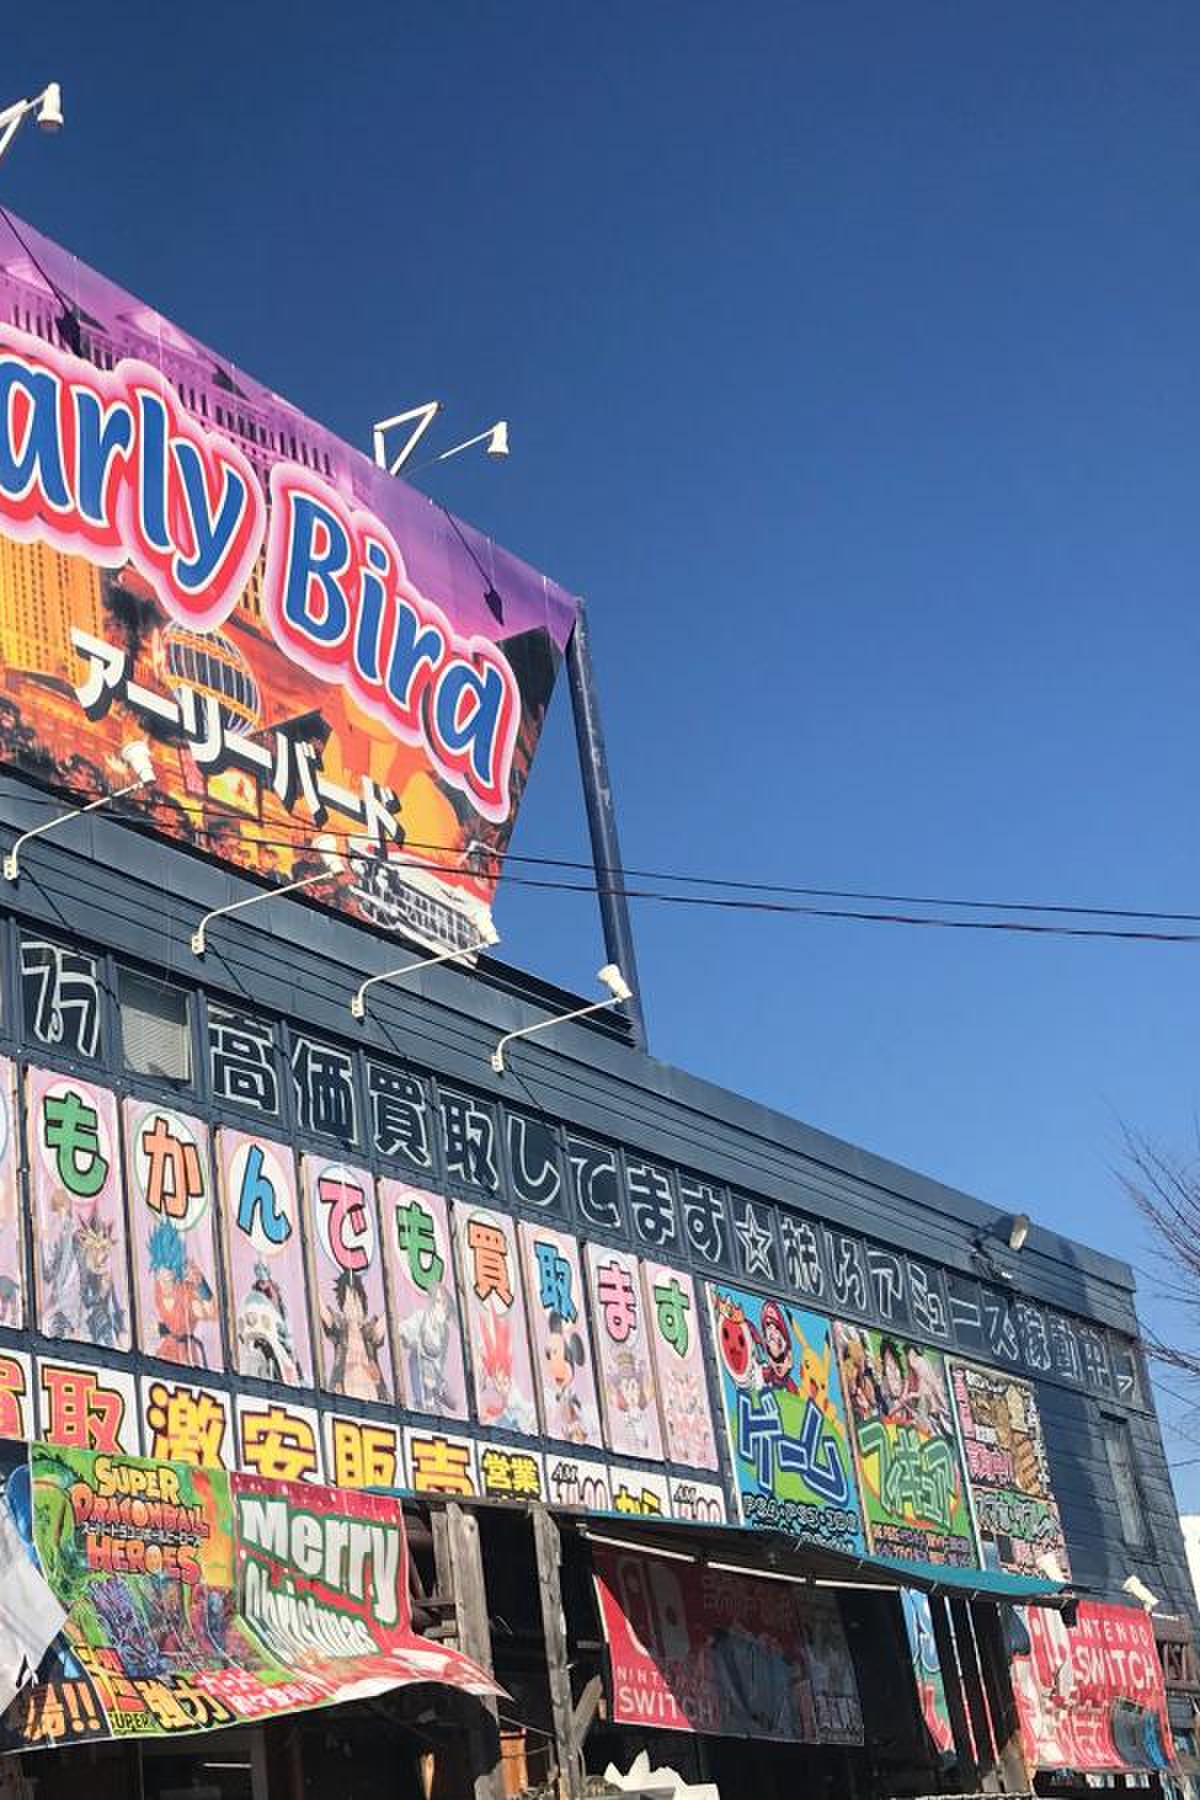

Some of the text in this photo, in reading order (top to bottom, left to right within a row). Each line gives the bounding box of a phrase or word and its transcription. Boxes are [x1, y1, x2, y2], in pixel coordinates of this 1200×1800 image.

[282, 488, 506, 793] Bird
[71, 626, 404, 854] アーリーバード
[94, 1455, 180, 1504] SUPER
[738, 1392, 848, 1504] ゲーム
[86, 1533, 202, 1585] HEROES
[238, 1494, 398, 1624] Merry
[618, 1686, 722, 1726] SWITCH
[1074, 1644, 1159, 1691] SWITCH
